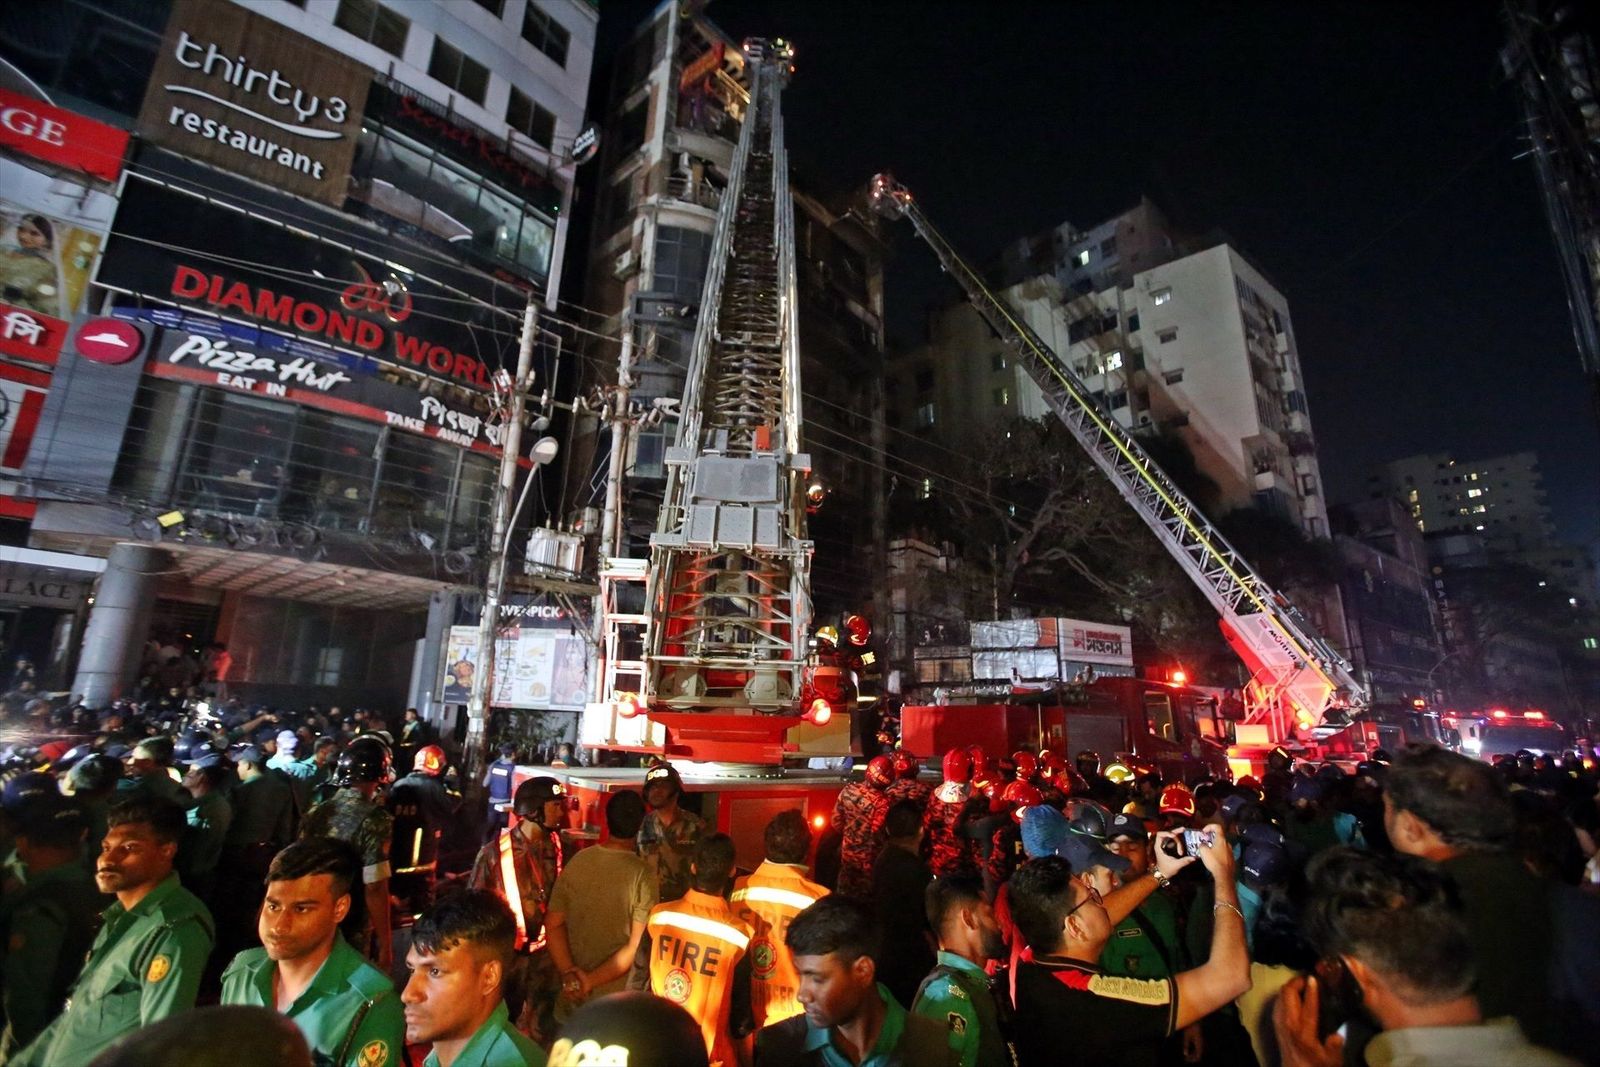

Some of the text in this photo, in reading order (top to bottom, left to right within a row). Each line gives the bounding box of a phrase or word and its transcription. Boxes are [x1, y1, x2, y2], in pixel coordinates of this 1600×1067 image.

[175, 31, 349, 125] thirty 3
[0, 102, 67, 147] GE
[168, 105, 325, 180] restaurant
[171, 265, 384, 351] DIAMOND
[394, 331, 508, 391] WORL
[169, 335, 276, 372] Pizza
[279, 358, 352, 391] Hut
[216, 372, 287, 397] EAT IN
[385, 410, 475, 447] TAKE AWAY
[1268, 629, 1298, 662] MORITA
[658, 934, 722, 977] FIRE
